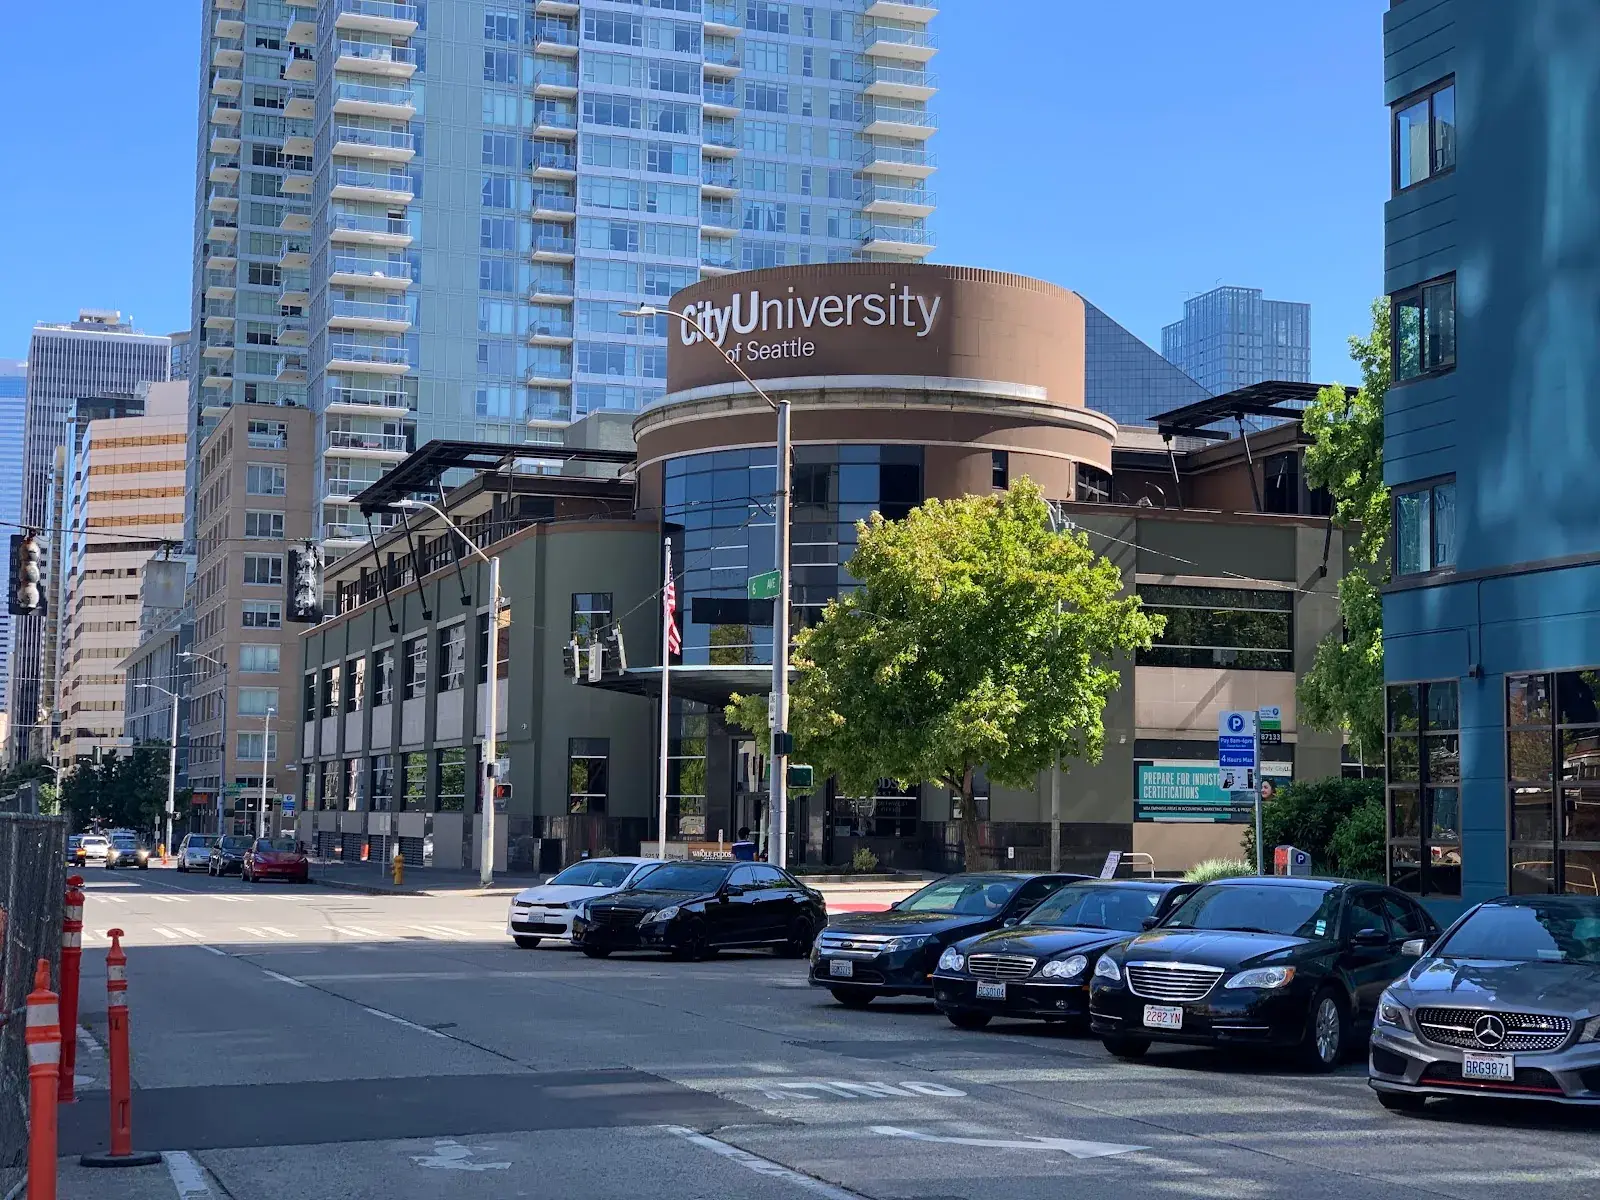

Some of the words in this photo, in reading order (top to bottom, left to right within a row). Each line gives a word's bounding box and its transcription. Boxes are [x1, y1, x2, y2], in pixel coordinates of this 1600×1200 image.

[725, 341, 742, 364] of
[746, 336, 815, 362] Seattle
[752, 582, 757, 596] 6
[1260, 733, 1281, 741] 87133
[1221, 754, 1226, 763] 4
[1143, 772, 1175, 785] PREPARE
[1176, 772, 1190, 786] FOR
[1143, 785, 1200, 800] CERTIFICATIONS
[691, 850, 713, 858] WHOLE
[1297, 854, 1304, 863] P
[1146, 1010, 1168, 1023] 2282
[1170, 1012, 1181, 1024] YN
[1466, 1060, 1509, 1076] BRG9871
